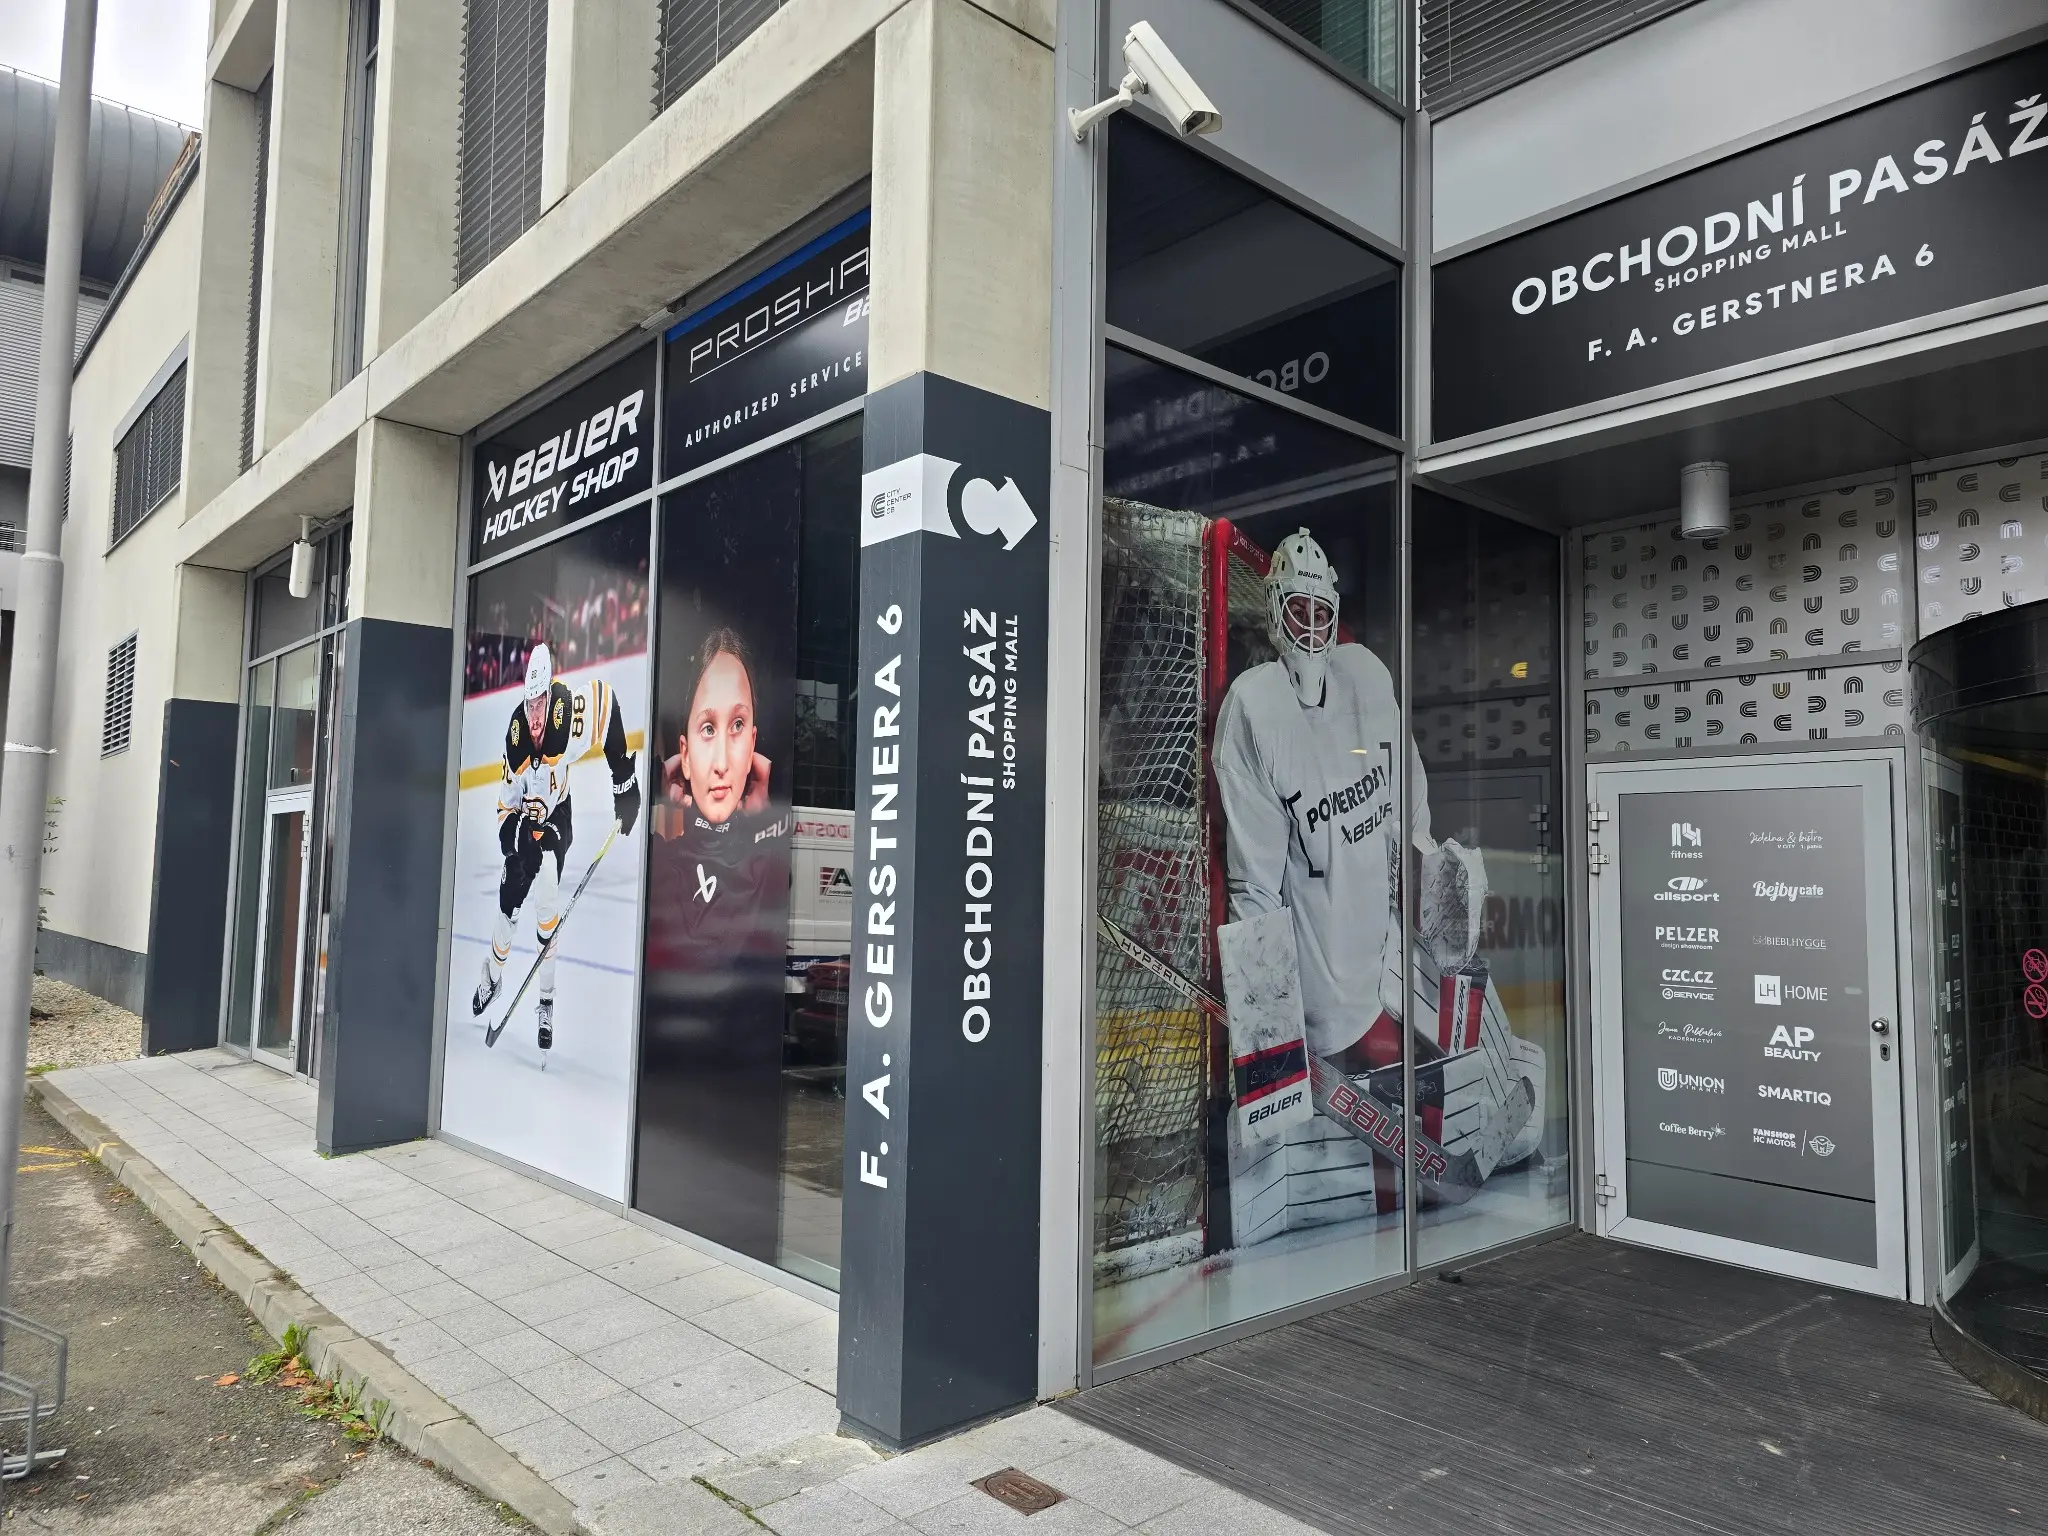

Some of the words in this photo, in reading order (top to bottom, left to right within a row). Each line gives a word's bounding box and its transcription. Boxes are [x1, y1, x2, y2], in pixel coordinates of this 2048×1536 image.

[1511, 173, 1807, 316] OBCHODNÍ
[1828, 93, 2048, 216] PASÁŽ
[1653, 244, 1771, 293] SHOPPING
[1781, 221, 1847, 251] MALL
[1587, 338, 1612, 362] F.
[1625, 326, 1658, 352] A.
[1672, 252, 1897, 337] GERSTNERA
[1914, 242, 1935, 267] 6
[685, 392, 780, 448] AUTHORIZED
[790, 351, 864, 398] SERVICE
[507, 388, 644, 501] BAUER
[482, 480, 568, 544] HOCKEY
[568, 446, 639, 505] SHOP
[886, 487, 901, 498] CITY
[886, 492, 912, 506] CENTER
[1297, 569, 1323, 581] BAUER
[876, 604, 903, 635] 6
[1004, 614, 1019, 672] MALL
[963, 607, 997, 759] PASÁŽ
[1002, 677, 1018, 790] SHOPPING
[694, 817, 731, 834] BAER
[864, 653, 902, 1029] GERSTNERA
[1670, 850, 1703, 859] fitness
[1653, 891, 1720, 902] allsport
[1752, 880, 1799, 902] Bejby
[960, 772, 994, 1043] OBCHODNÍ
[1655, 926, 1720, 943] PELZER
[1680, 943, 1713, 951] showroom
[1662, 968, 1714, 984] CZC.CZ
[1759, 983, 1776, 998] LH
[1784, 984, 1828, 1002] HOME
[1769, 1024, 1815, 1048] AP
[1764, 1046, 1822, 1062] BEAUTY
[862, 1053, 891, 1120] A.
[1679, 1073, 1725, 1090] UNION
[1758, 1084, 1832, 1107] SMARTIQ
[1248, 1091, 1303, 1126] BAUER
[1659, 1122, 1687, 1135] Coffee
[1688, 1125, 1715, 1141] Berry
[1753, 1127, 1796, 1141] FANSHOP
[1753, 1135, 1765, 1144] HC
[1766, 1137, 1797, 1149] MOTOR
[860, 1141, 889, 1189] F.
